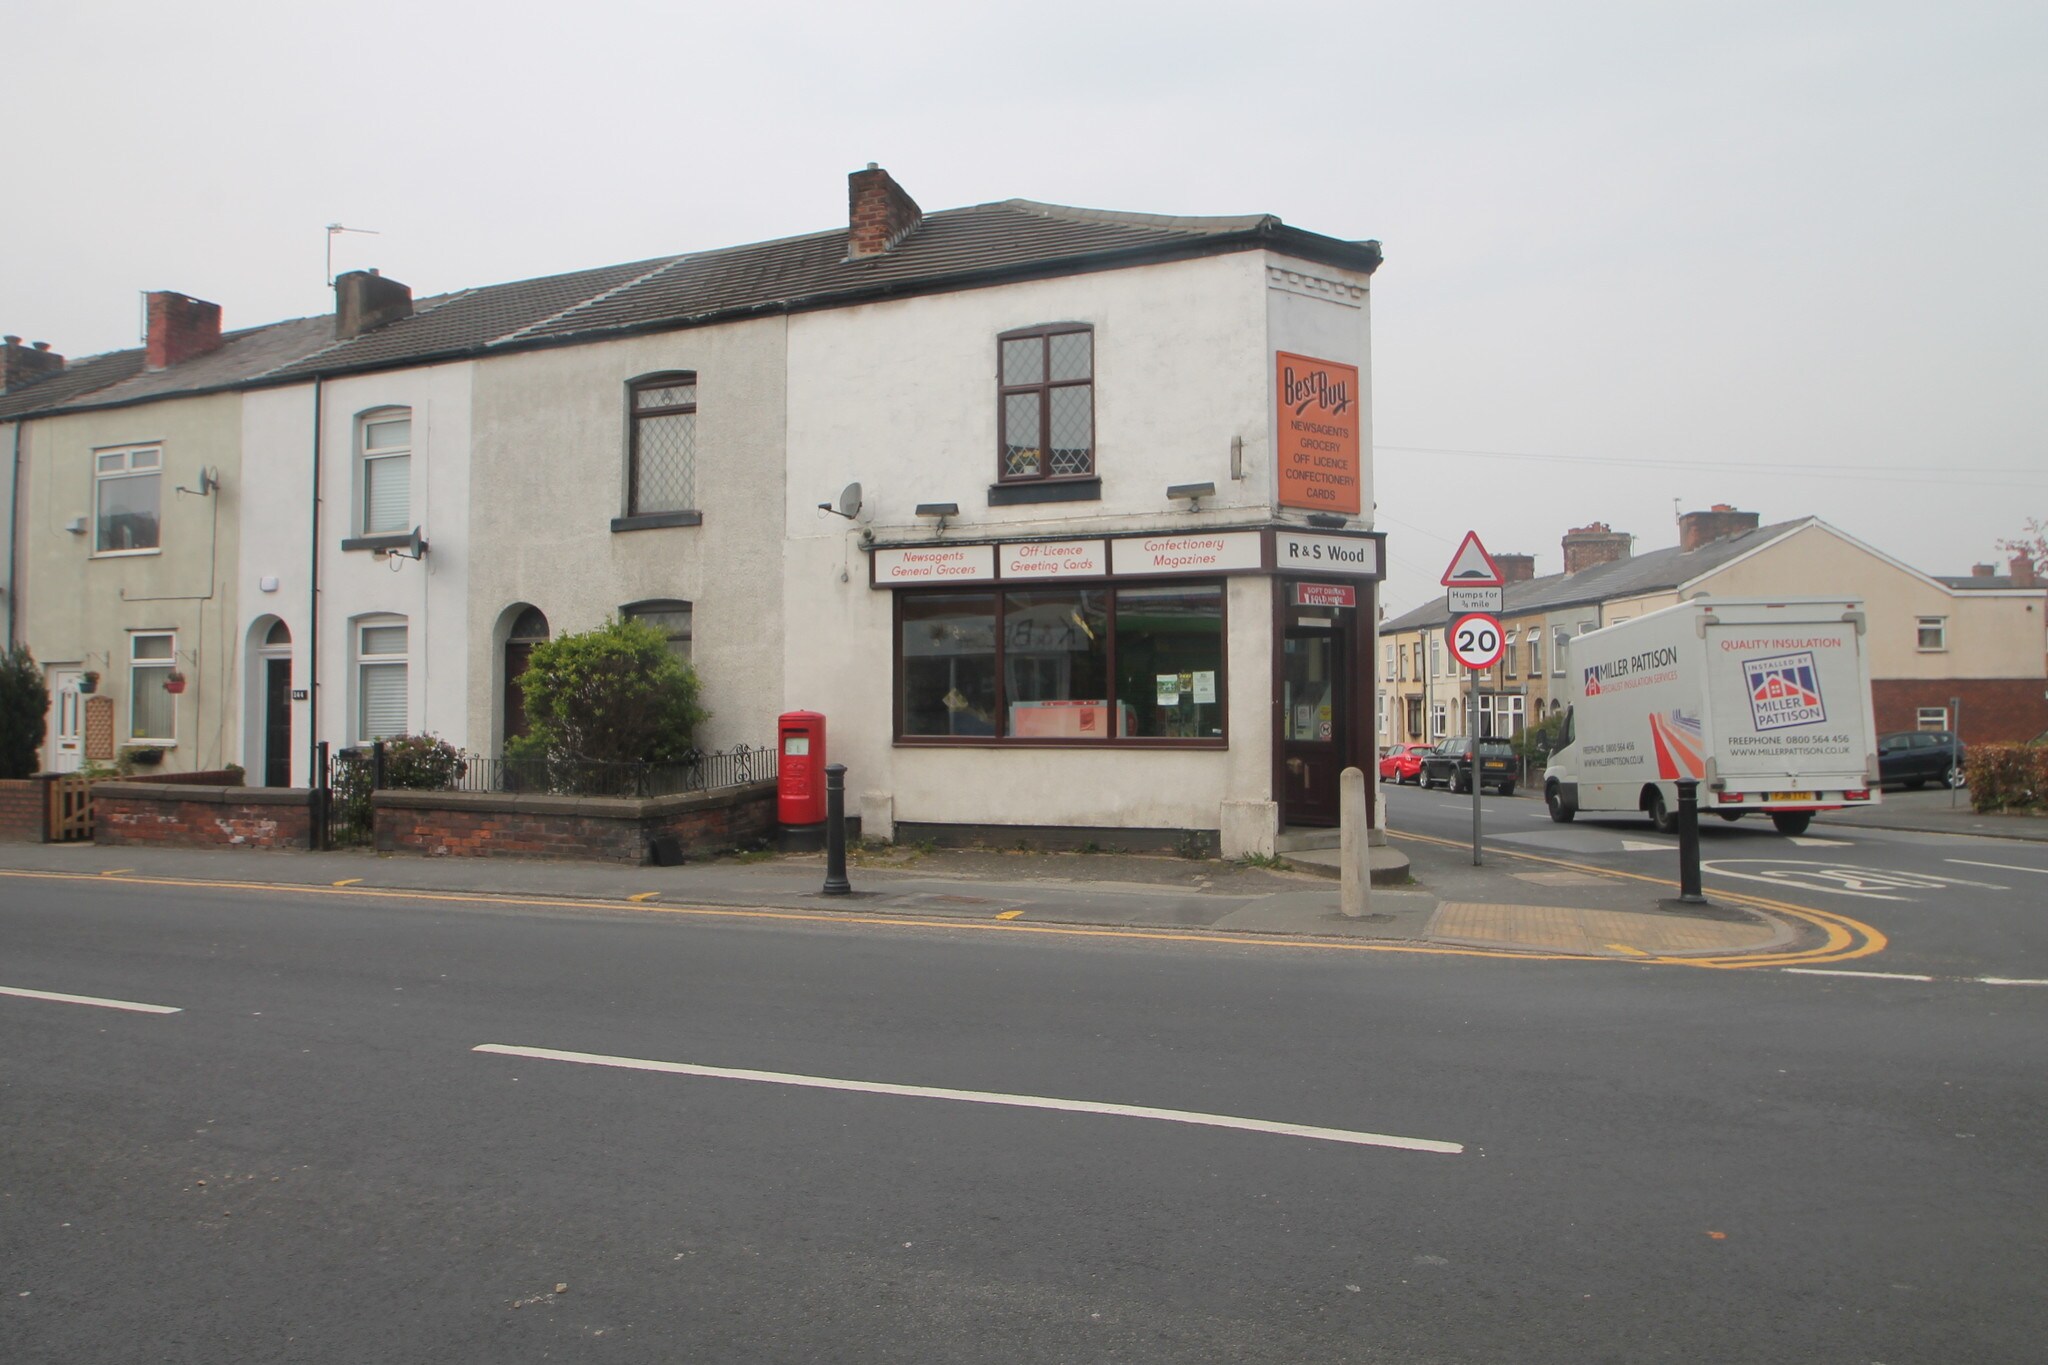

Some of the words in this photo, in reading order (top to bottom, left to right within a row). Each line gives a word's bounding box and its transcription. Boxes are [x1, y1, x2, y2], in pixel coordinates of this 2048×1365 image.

[1284, 366, 1318, 406] Best
[1318, 370, 1353, 416] Buy
[1291, 420, 1349, 439] NEWSAGENTS
[1300, 437, 1341, 453] GROCERY
[1293, 453, 1310, 465] OFF
[1313, 456, 1348, 470] LICENCE
[1285, 468, 1355, 487] CONFECTIONERY
[1306, 487, 1336, 501] CARDS
[1143, 538, 1225, 552] Confectionery
[1289, 542, 1299, 559] R
[1301, 546, 1310, 557] &
[1312, 545, 1322, 560] S
[1328, 545, 1365, 563] Wood
[902, 551, 965, 564] Newsagents
[1153, 553, 1216, 569] Magazines
[891, 565, 932, 577] General
[936, 564, 977, 576] Grocers
[1010, 560, 1059, 574] Greeting
[1063, 558, 1094, 570] Cards
[1307, 586, 1323, 594] SOFT
[1452, 591, 1484, 599] Humps
[1471, 600, 1490, 608] mile
[1458, 630, 1497, 652] 20
[1721, 639, 1769, 652] QUALITY
[1772, 637, 1841, 649] INSULATION
[1599, 658, 1629, 680] MILLER
[1631, 645, 1678, 674] PATTISON
[1748, 659, 1795, 672] INSTALLED
[1623, 675, 1654, 690] INSULATION
[1653, 670, 1678, 685] SERVICES
[1756, 697, 1801, 714] MILLER
[1758, 707, 1820, 726] PATTISON
[1728, 736, 1781, 745] FREEPHONE
[1785, 735, 1810, 744] 0800
[1812, 734, 1829, 743] 564
[1832, 734, 1850, 743] 456
[1730, 746, 1850, 756] WWW.MILLERPATTISON.CO.UK
